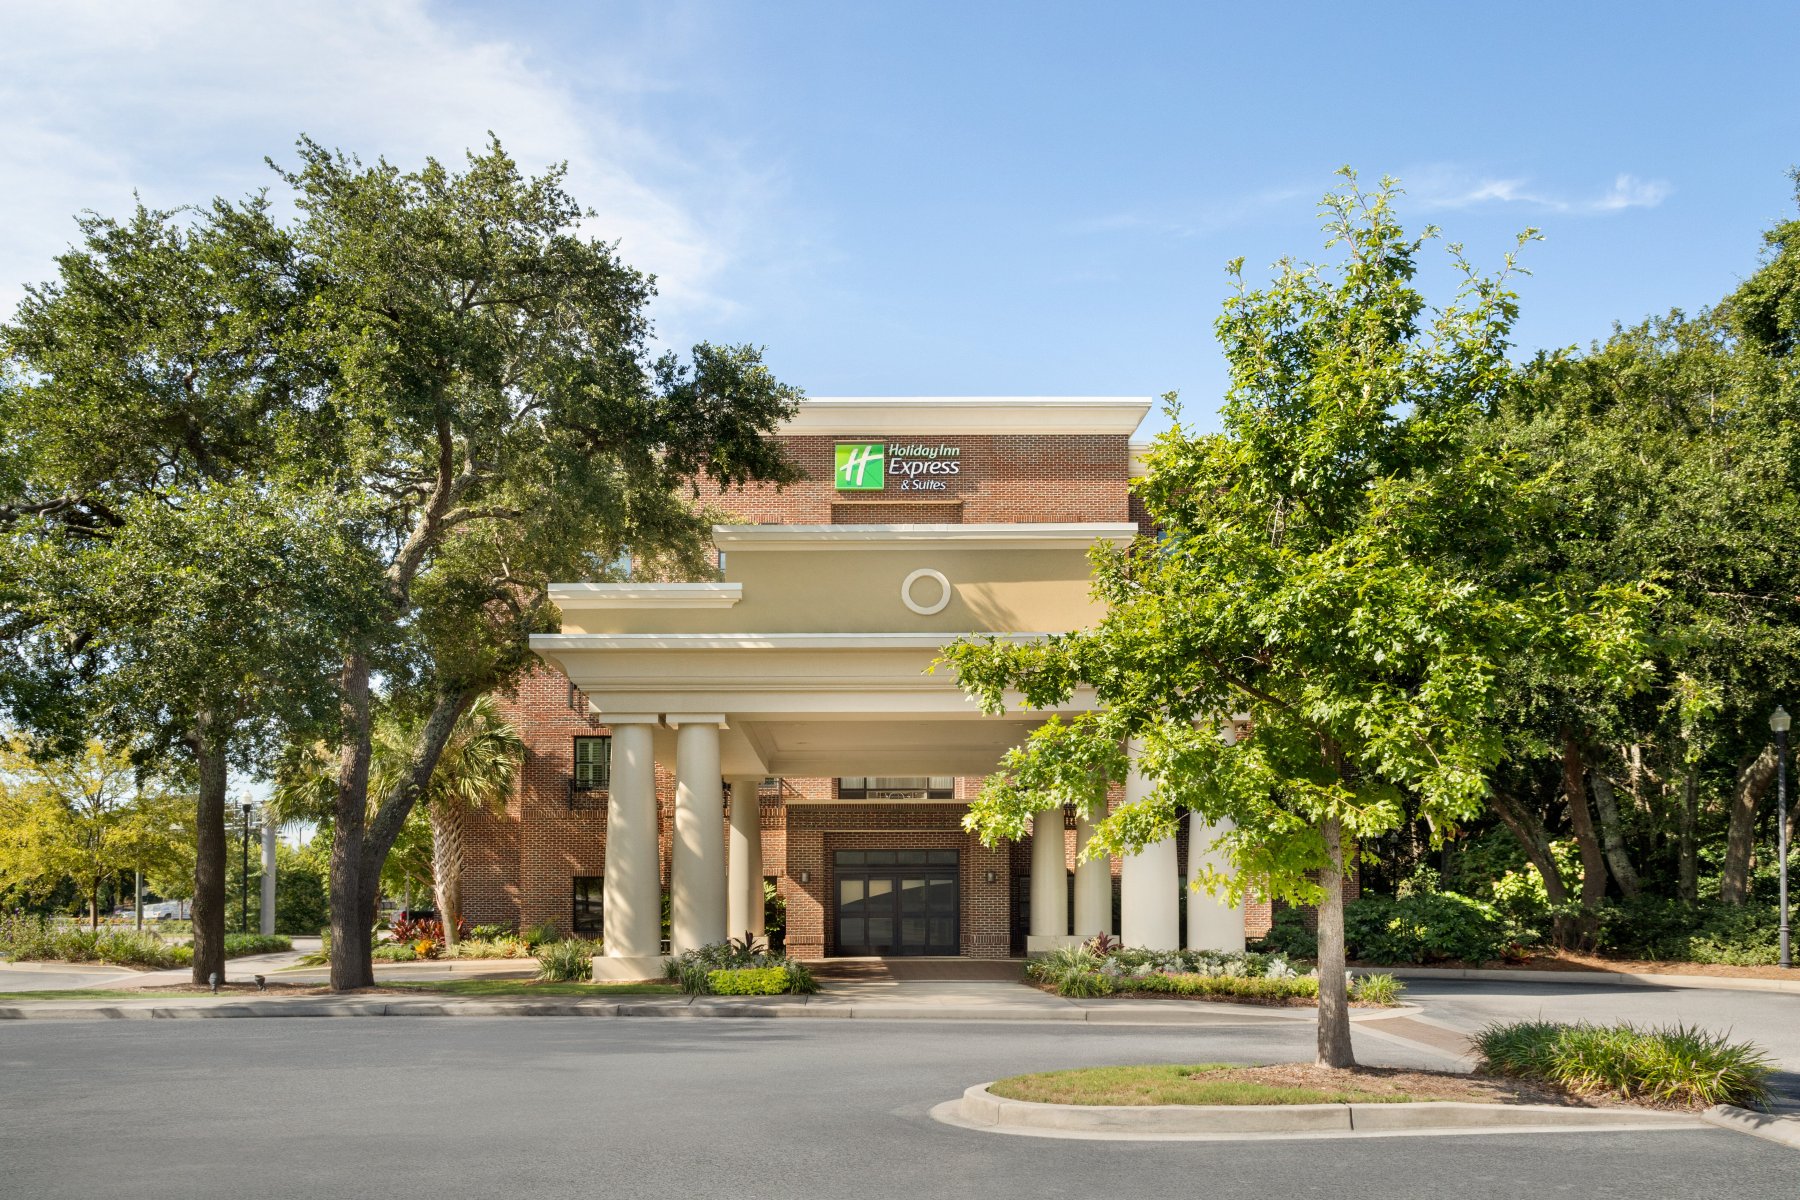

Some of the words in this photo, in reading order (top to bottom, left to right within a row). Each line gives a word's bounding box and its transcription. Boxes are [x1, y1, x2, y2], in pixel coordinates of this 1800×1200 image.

[889, 443, 939, 459] Holiday
[940, 443, 960, 456] Inn
[889, 457, 961, 478] Express
[901, 480, 910, 490] &
[912, 479, 946, 490] Suites
